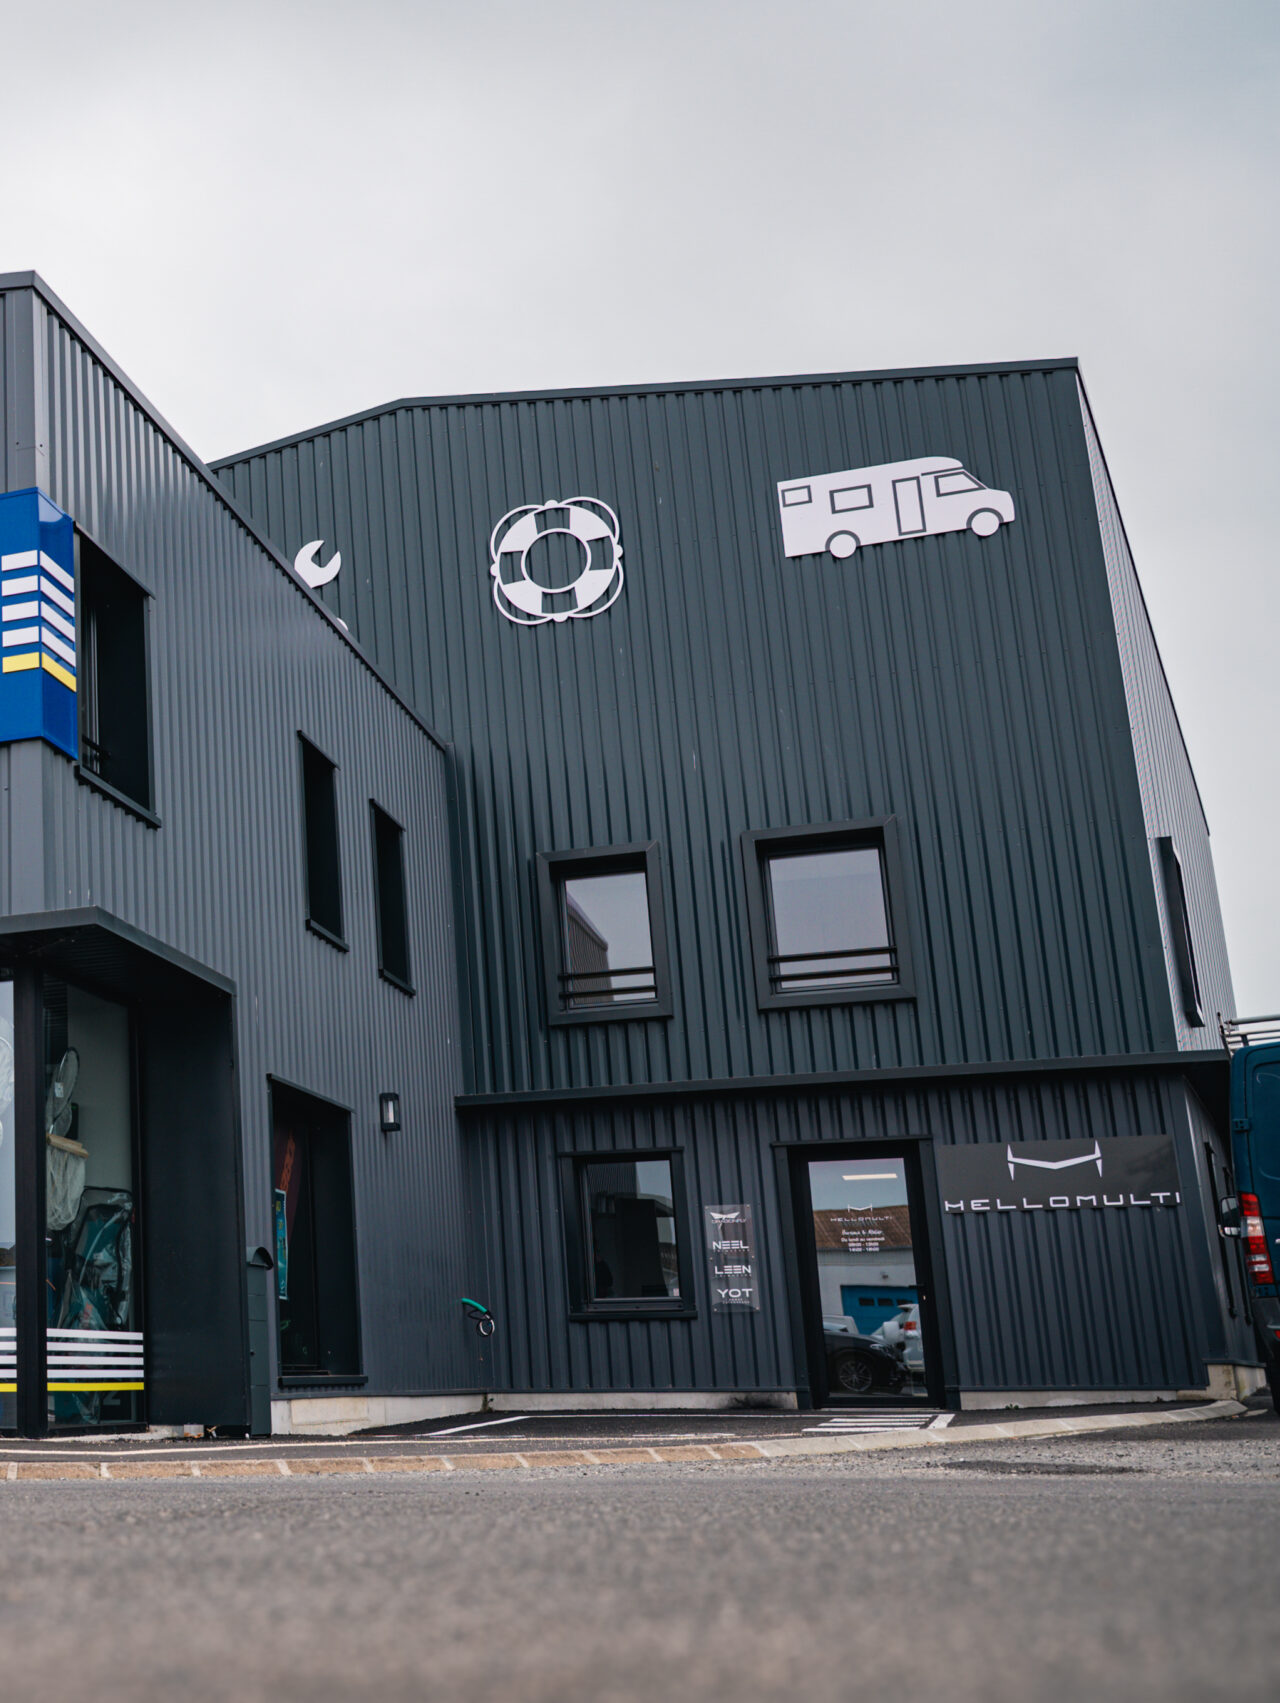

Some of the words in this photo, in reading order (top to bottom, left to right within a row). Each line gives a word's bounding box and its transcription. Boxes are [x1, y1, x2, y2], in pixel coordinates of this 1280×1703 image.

[944, 1191, 1180, 1212] HELLOMULTI
[712, 1240, 749, 1250] NEEL
[714, 1264, 752, 1275] LEEN
[716, 1288, 753, 1298] YOT
